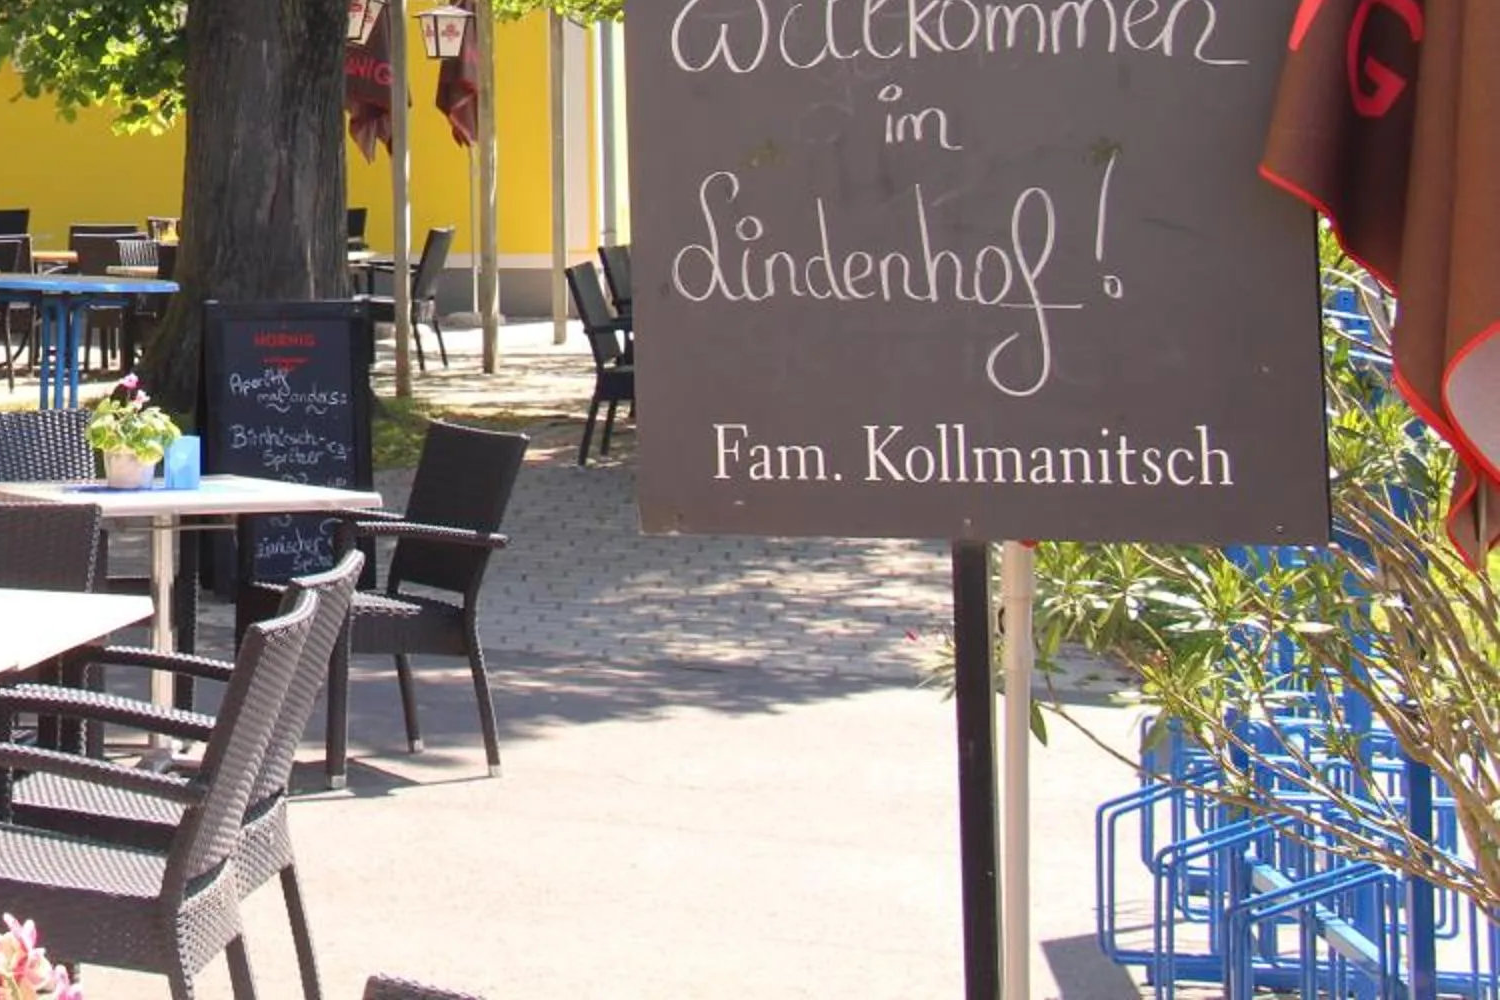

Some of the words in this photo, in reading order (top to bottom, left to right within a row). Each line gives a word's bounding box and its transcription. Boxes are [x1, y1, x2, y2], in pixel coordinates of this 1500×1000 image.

[878, 84, 963, 150] im
[713, 423, 843, 482] Fam.
[863, 424, 1234, 487] Kollmanitsch
